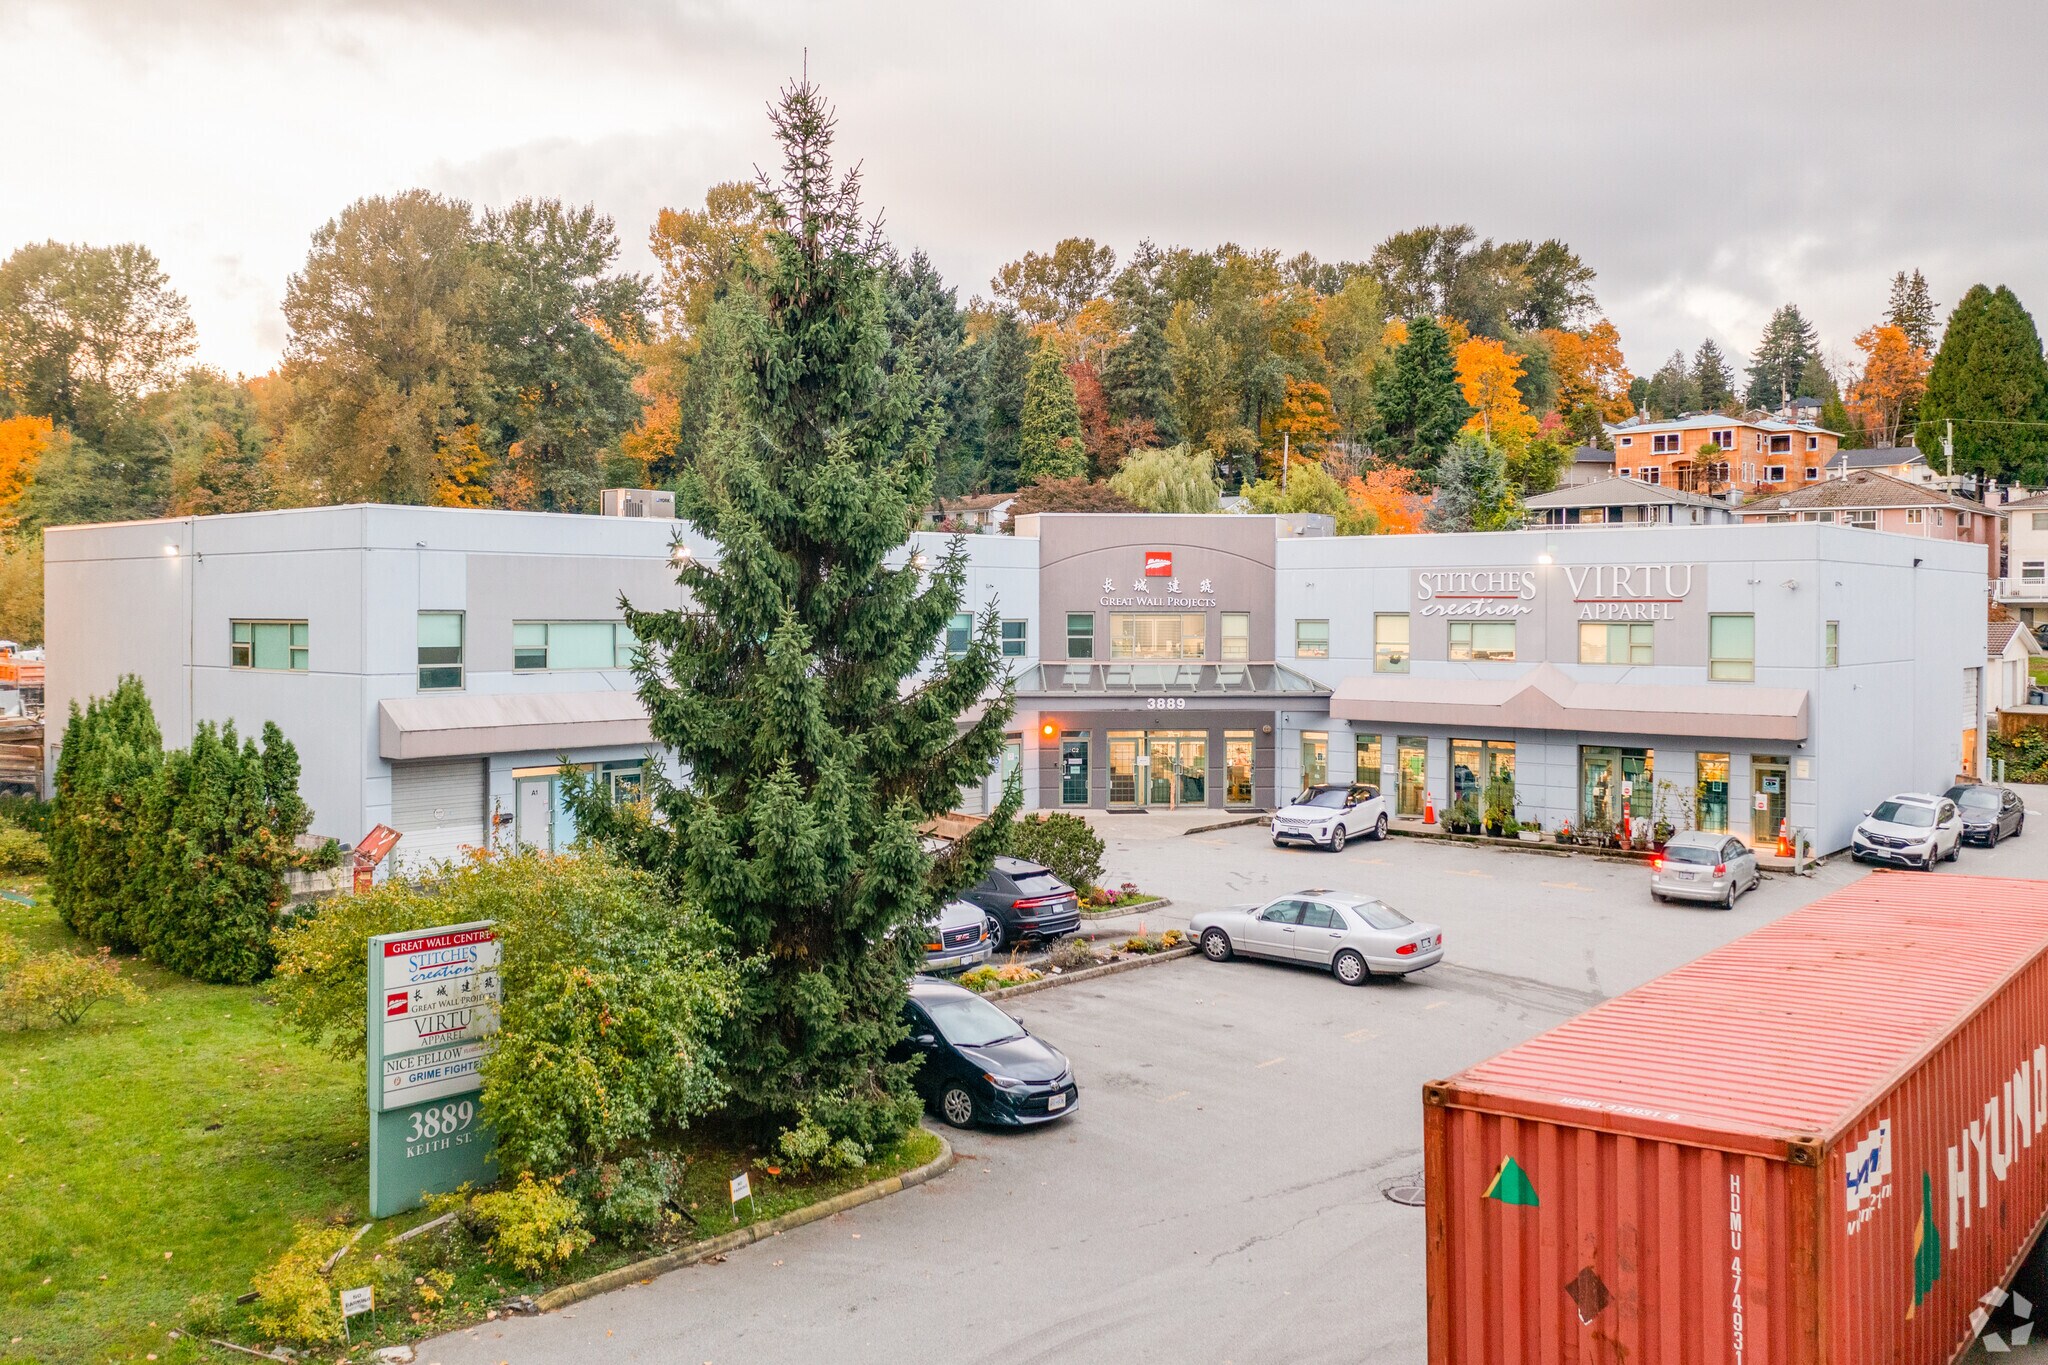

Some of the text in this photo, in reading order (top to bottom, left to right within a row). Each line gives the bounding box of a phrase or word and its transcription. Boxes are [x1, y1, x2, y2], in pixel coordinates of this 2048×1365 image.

[1417, 571, 1536, 600] STITCHES
[1563, 564, 1694, 599] VIRTU
[1419, 598, 1533, 617] creation
[1579, 602, 1675, 620] APPAREL
[1146, 698, 1186, 710] 3889
[392, 931, 491, 953] GREAT WALL CENTRE
[409, 945, 478, 973] STITCHES
[410, 965, 475, 982] creation
[414, 1009, 473, 1034] VIRTU
[421, 1030, 464, 1047] APPAREL
[387, 1058, 415, 1073] NICE
[417, 1047, 464, 1067] FELLOW
[409, 1068, 442, 1083] GRIME
[406, 1101, 474, 1143] 3889
[406, 1132, 472, 1158] KEITH ST.
[1729, 1174, 1744, 1365] HDMU 474931
